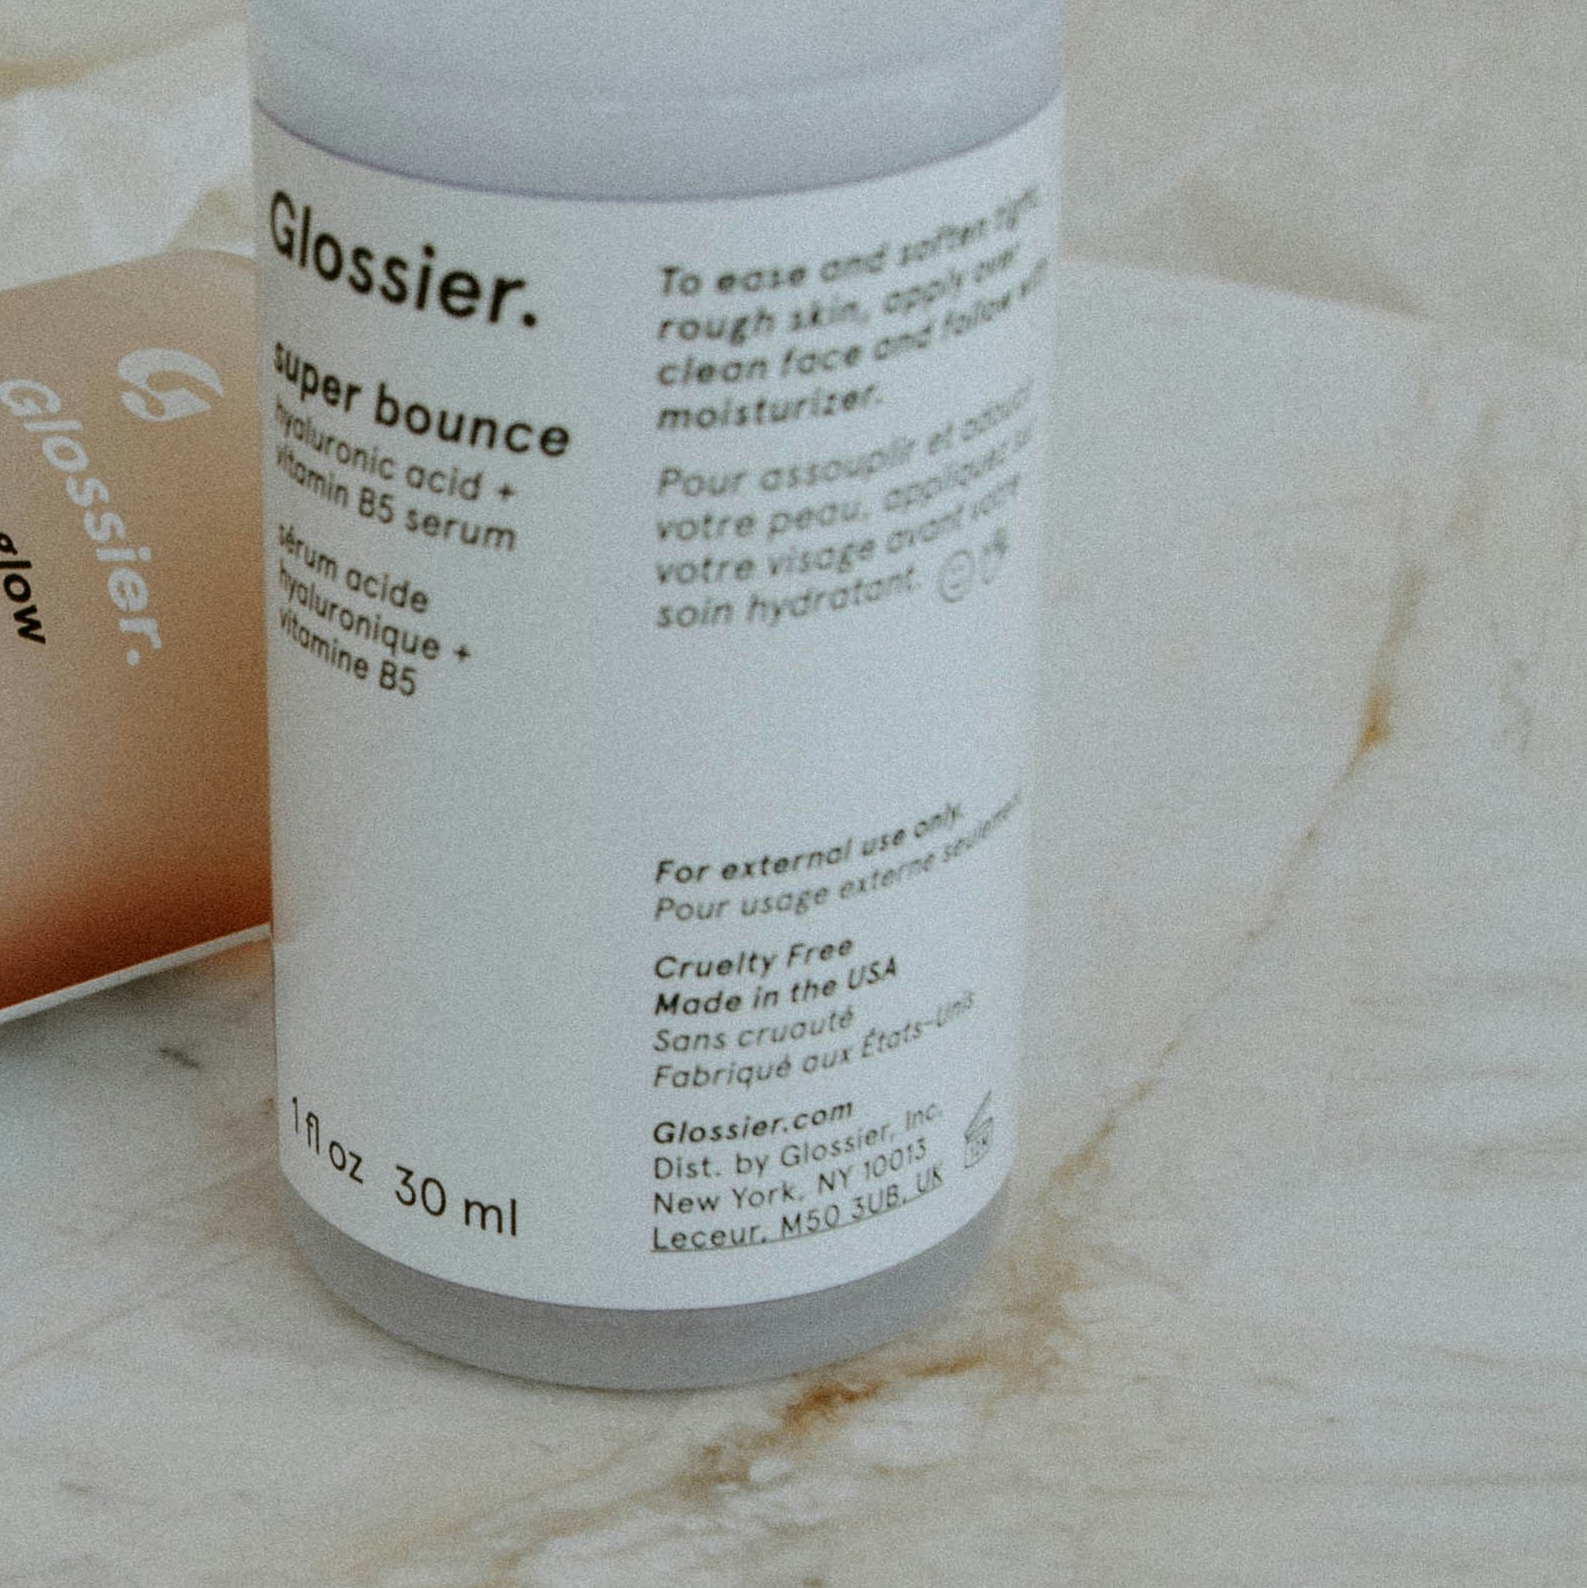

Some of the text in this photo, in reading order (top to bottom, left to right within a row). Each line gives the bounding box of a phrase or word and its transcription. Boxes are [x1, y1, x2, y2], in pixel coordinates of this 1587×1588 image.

[270, 190, 539, 329] Glossier.
[658, 265, 702, 297] To
[715, 265, 809, 295] ease
[819, 240, 890, 283] and
[656, 305, 776, 348] rough
[657, 353, 769, 387] clean
[779, 343, 864, 379] face
[871, 317, 934, 362] and
[273, 340, 571, 459] super bounce
[655, 383, 885, 431] moisturizer.
[273, 392, 397, 481] hyaluronic
[405, 463, 485, 503] acid
[275, 442, 519, 552] vitamin B5 serum
[657, 463, 746, 498] Pour
[656, 511, 756, 544] votre
[346, 565, 429, 614] acide
[655, 557, 756, 586] votre
[768, 535, 878, 574] visage
[278, 557, 441, 661] hyaluronique
[656, 563, 922, 629] soin hydratant.
[279, 607, 418, 698] vitamine B5
[655, 860, 709, 884] For
[721, 836, 852, 881] external
[860, 828, 906, 858] use
[655, 893, 730, 923] Pour
[740, 886, 829, 917] usage
[838, 853, 936, 901] externe
[655, 938, 855, 980] Cruelty Free
[655, 956, 899, 1017] Made in the USA
[654, 1003, 856, 1054] Sans cruauté
[654, 1056, 792, 1089] Fabriqué
[802, 1048, 852, 1072] aux
[653, 1100, 855, 1145] Glossier.com
[654, 1151, 723, 1180] Dist.
[735, 1151, 770, 1182] by
[779, 1122, 896, 1170] Glossier,
[654, 1137, 928, 1214] New York, NY 10013
[915, 1163, 945, 1195] UK
[329, 1140, 364, 1184] oz
[395, 1164, 447, 1217] 30
[464, 1197, 518, 1237] ml
